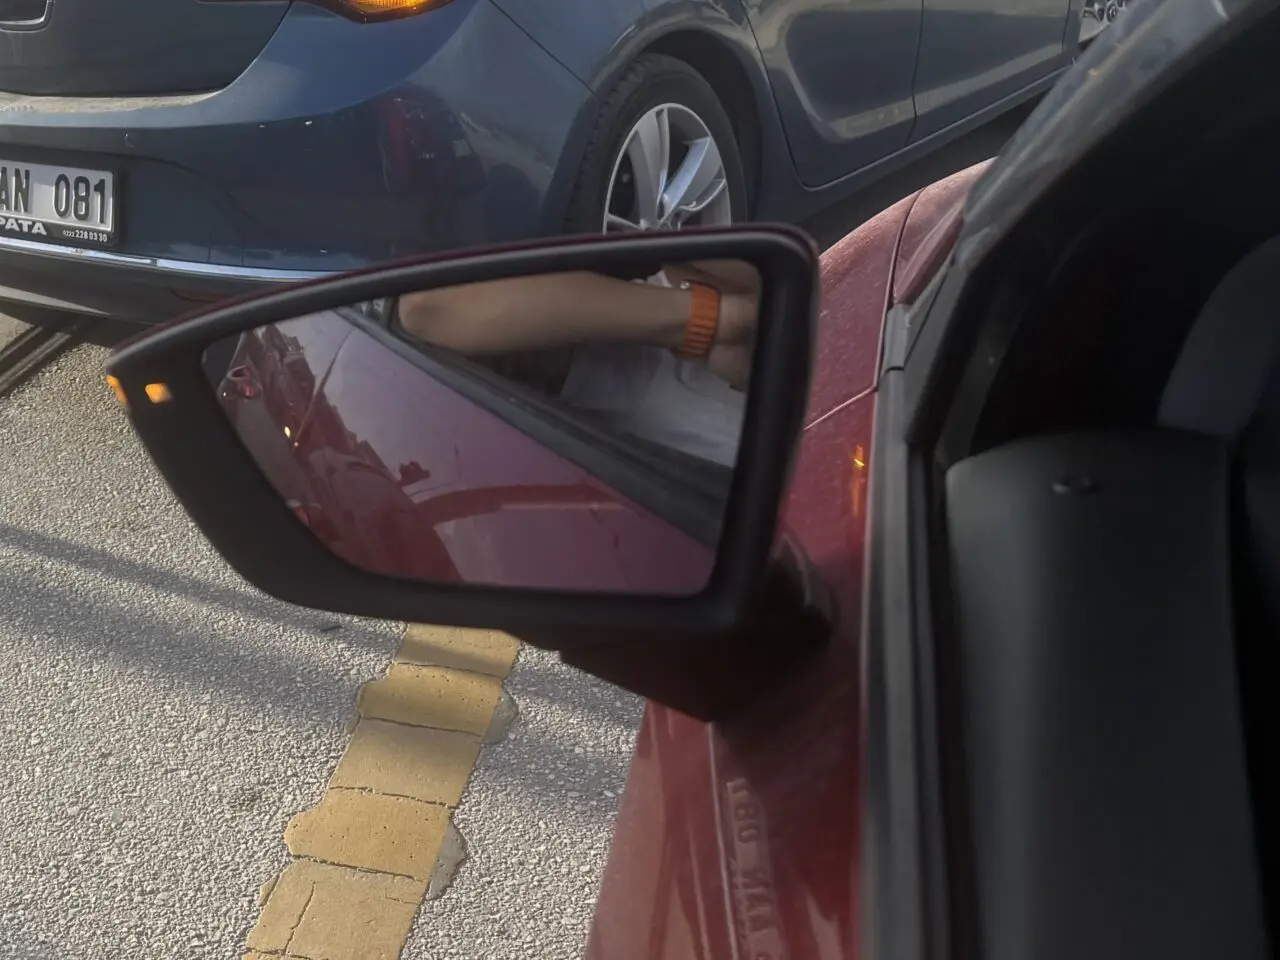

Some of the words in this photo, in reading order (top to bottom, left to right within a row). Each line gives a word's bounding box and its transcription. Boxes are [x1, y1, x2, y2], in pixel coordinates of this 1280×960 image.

[53, 173, 106, 225] 081
[75, 229, 88, 239] 228
[89, 231, 97, 240] 03
[98, 233, 107, 242] 30
